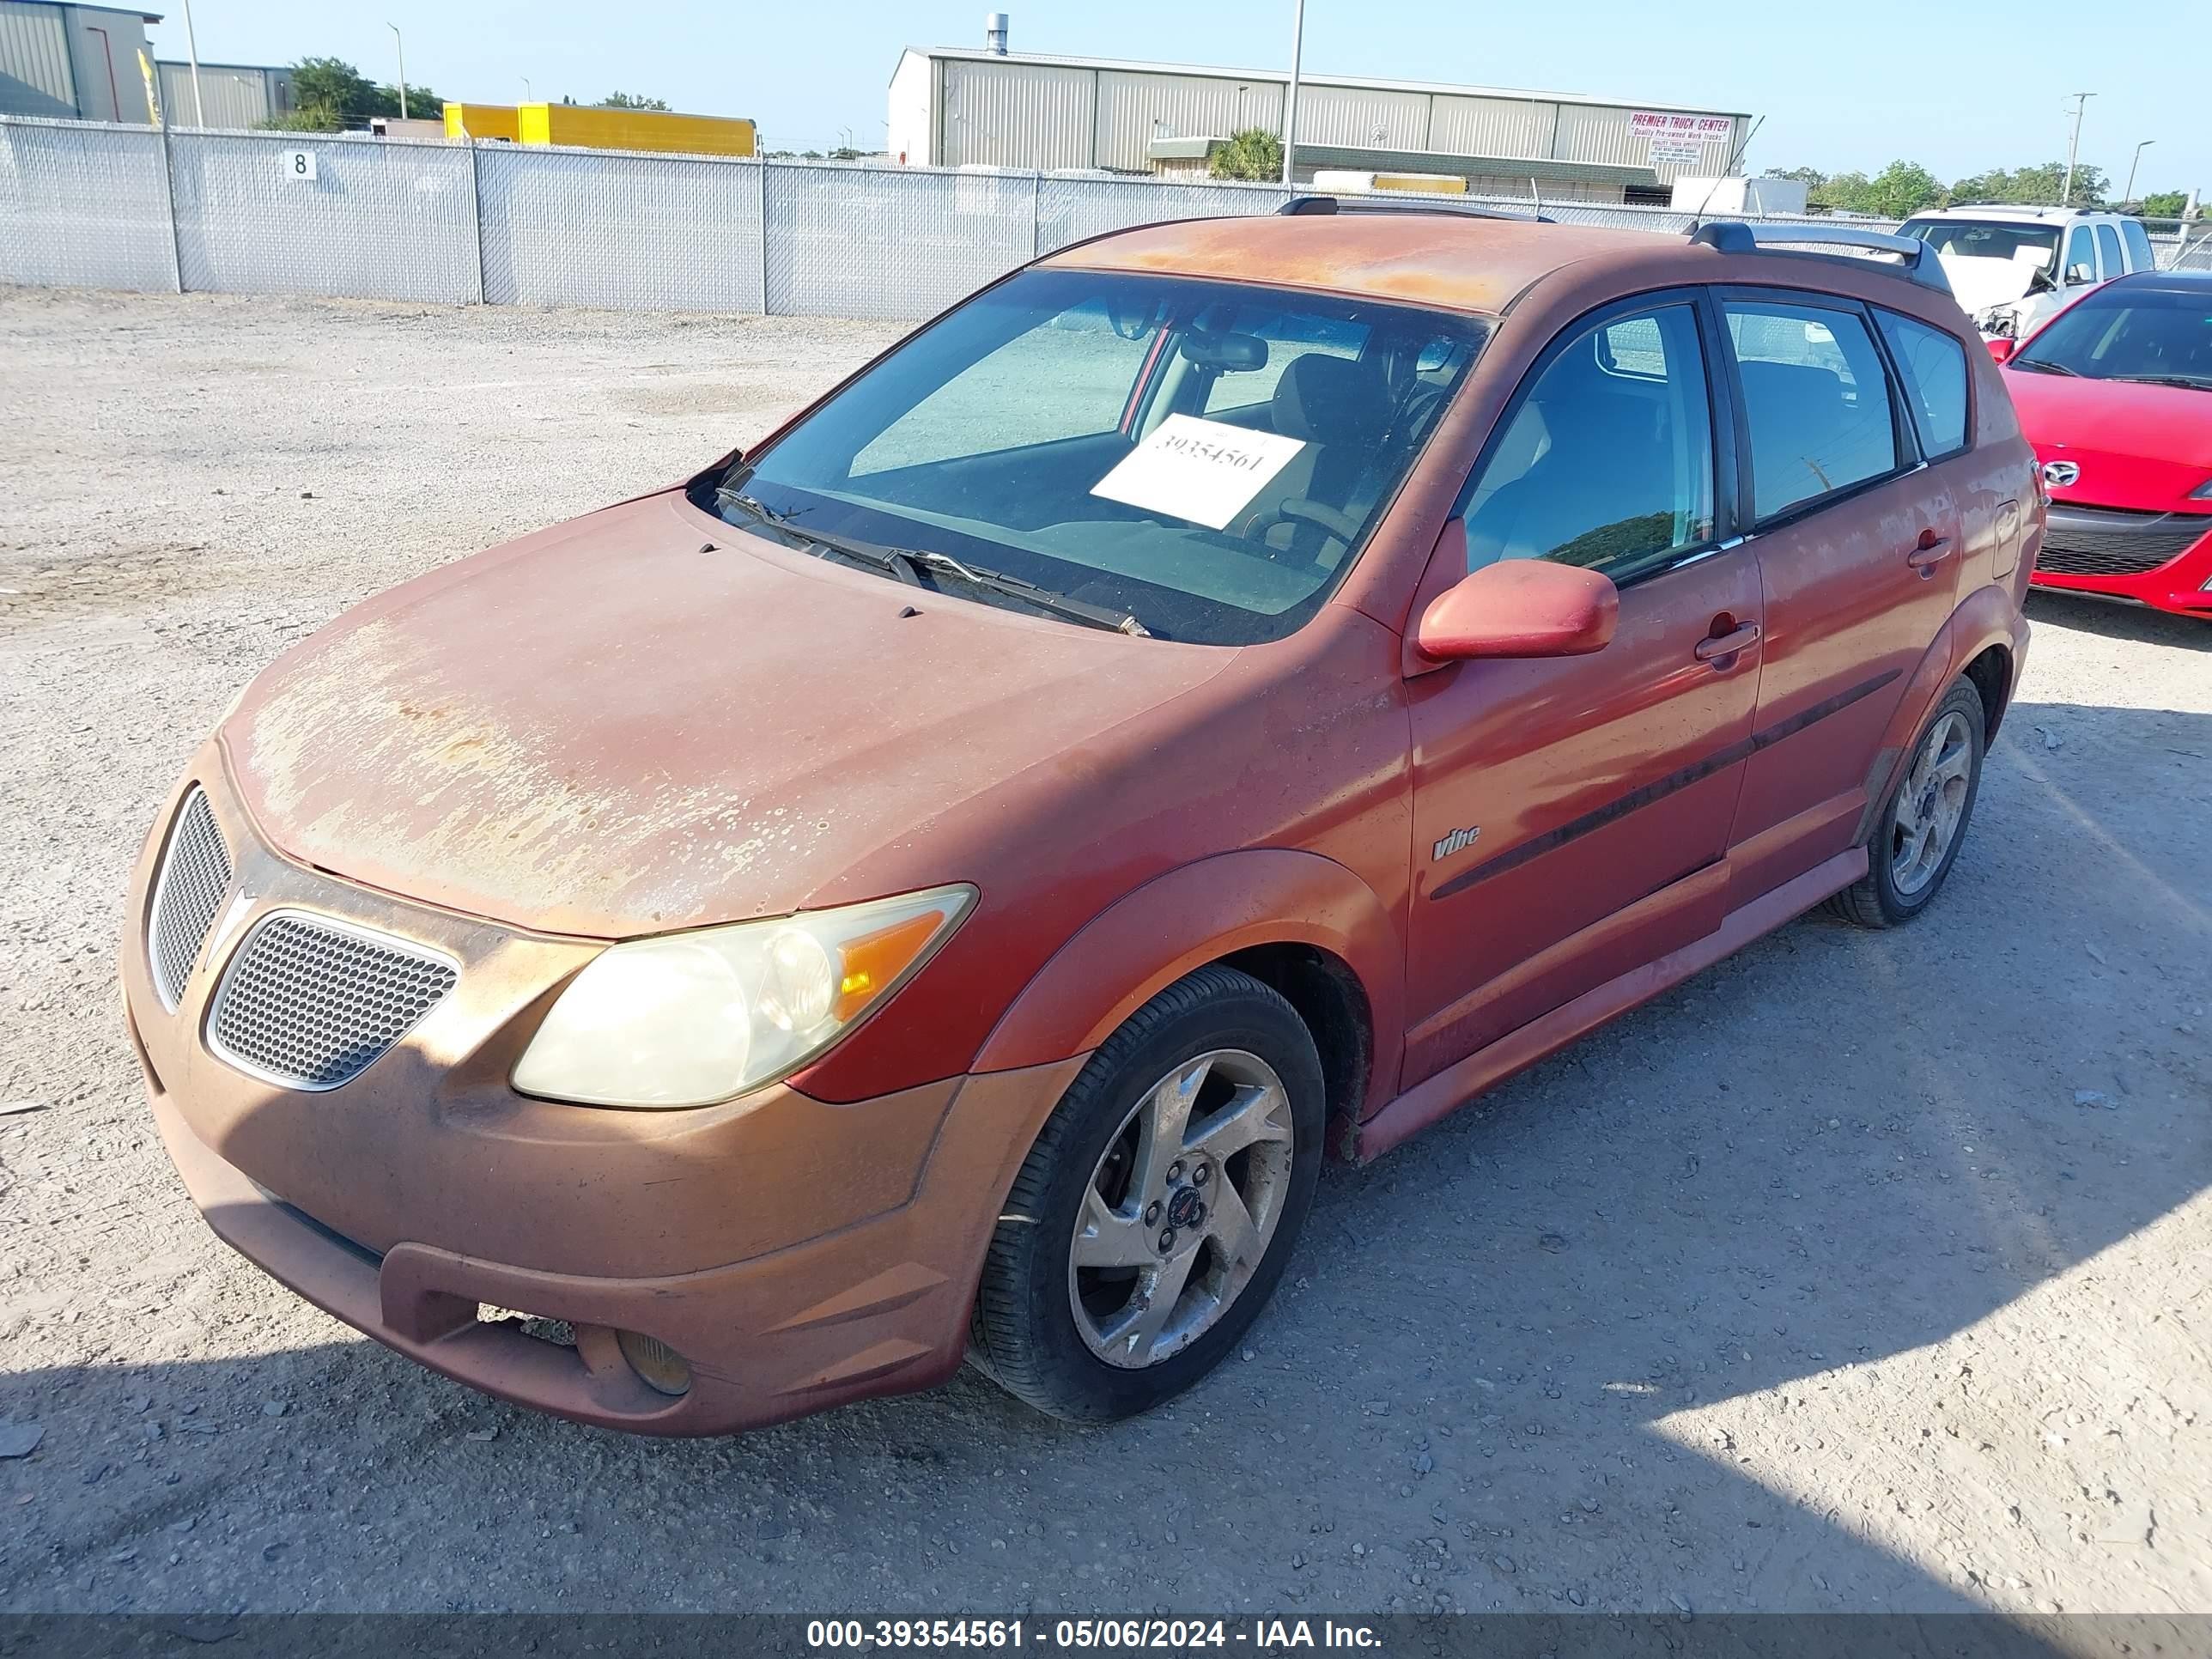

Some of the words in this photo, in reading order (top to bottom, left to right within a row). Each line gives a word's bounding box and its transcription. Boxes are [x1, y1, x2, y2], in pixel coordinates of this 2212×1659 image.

[1631, 114, 1667, 128] PREMIER
[1669, 117, 1697, 130] TRUCK
[1698, 118, 1729, 131] CENTER
[1656, 129, 1686, 138] Pre-owned
[1687, 131, 1701, 140] Work
[295, 154, 306, 173] 8
[1155, 434, 1265, 471] 39354561
